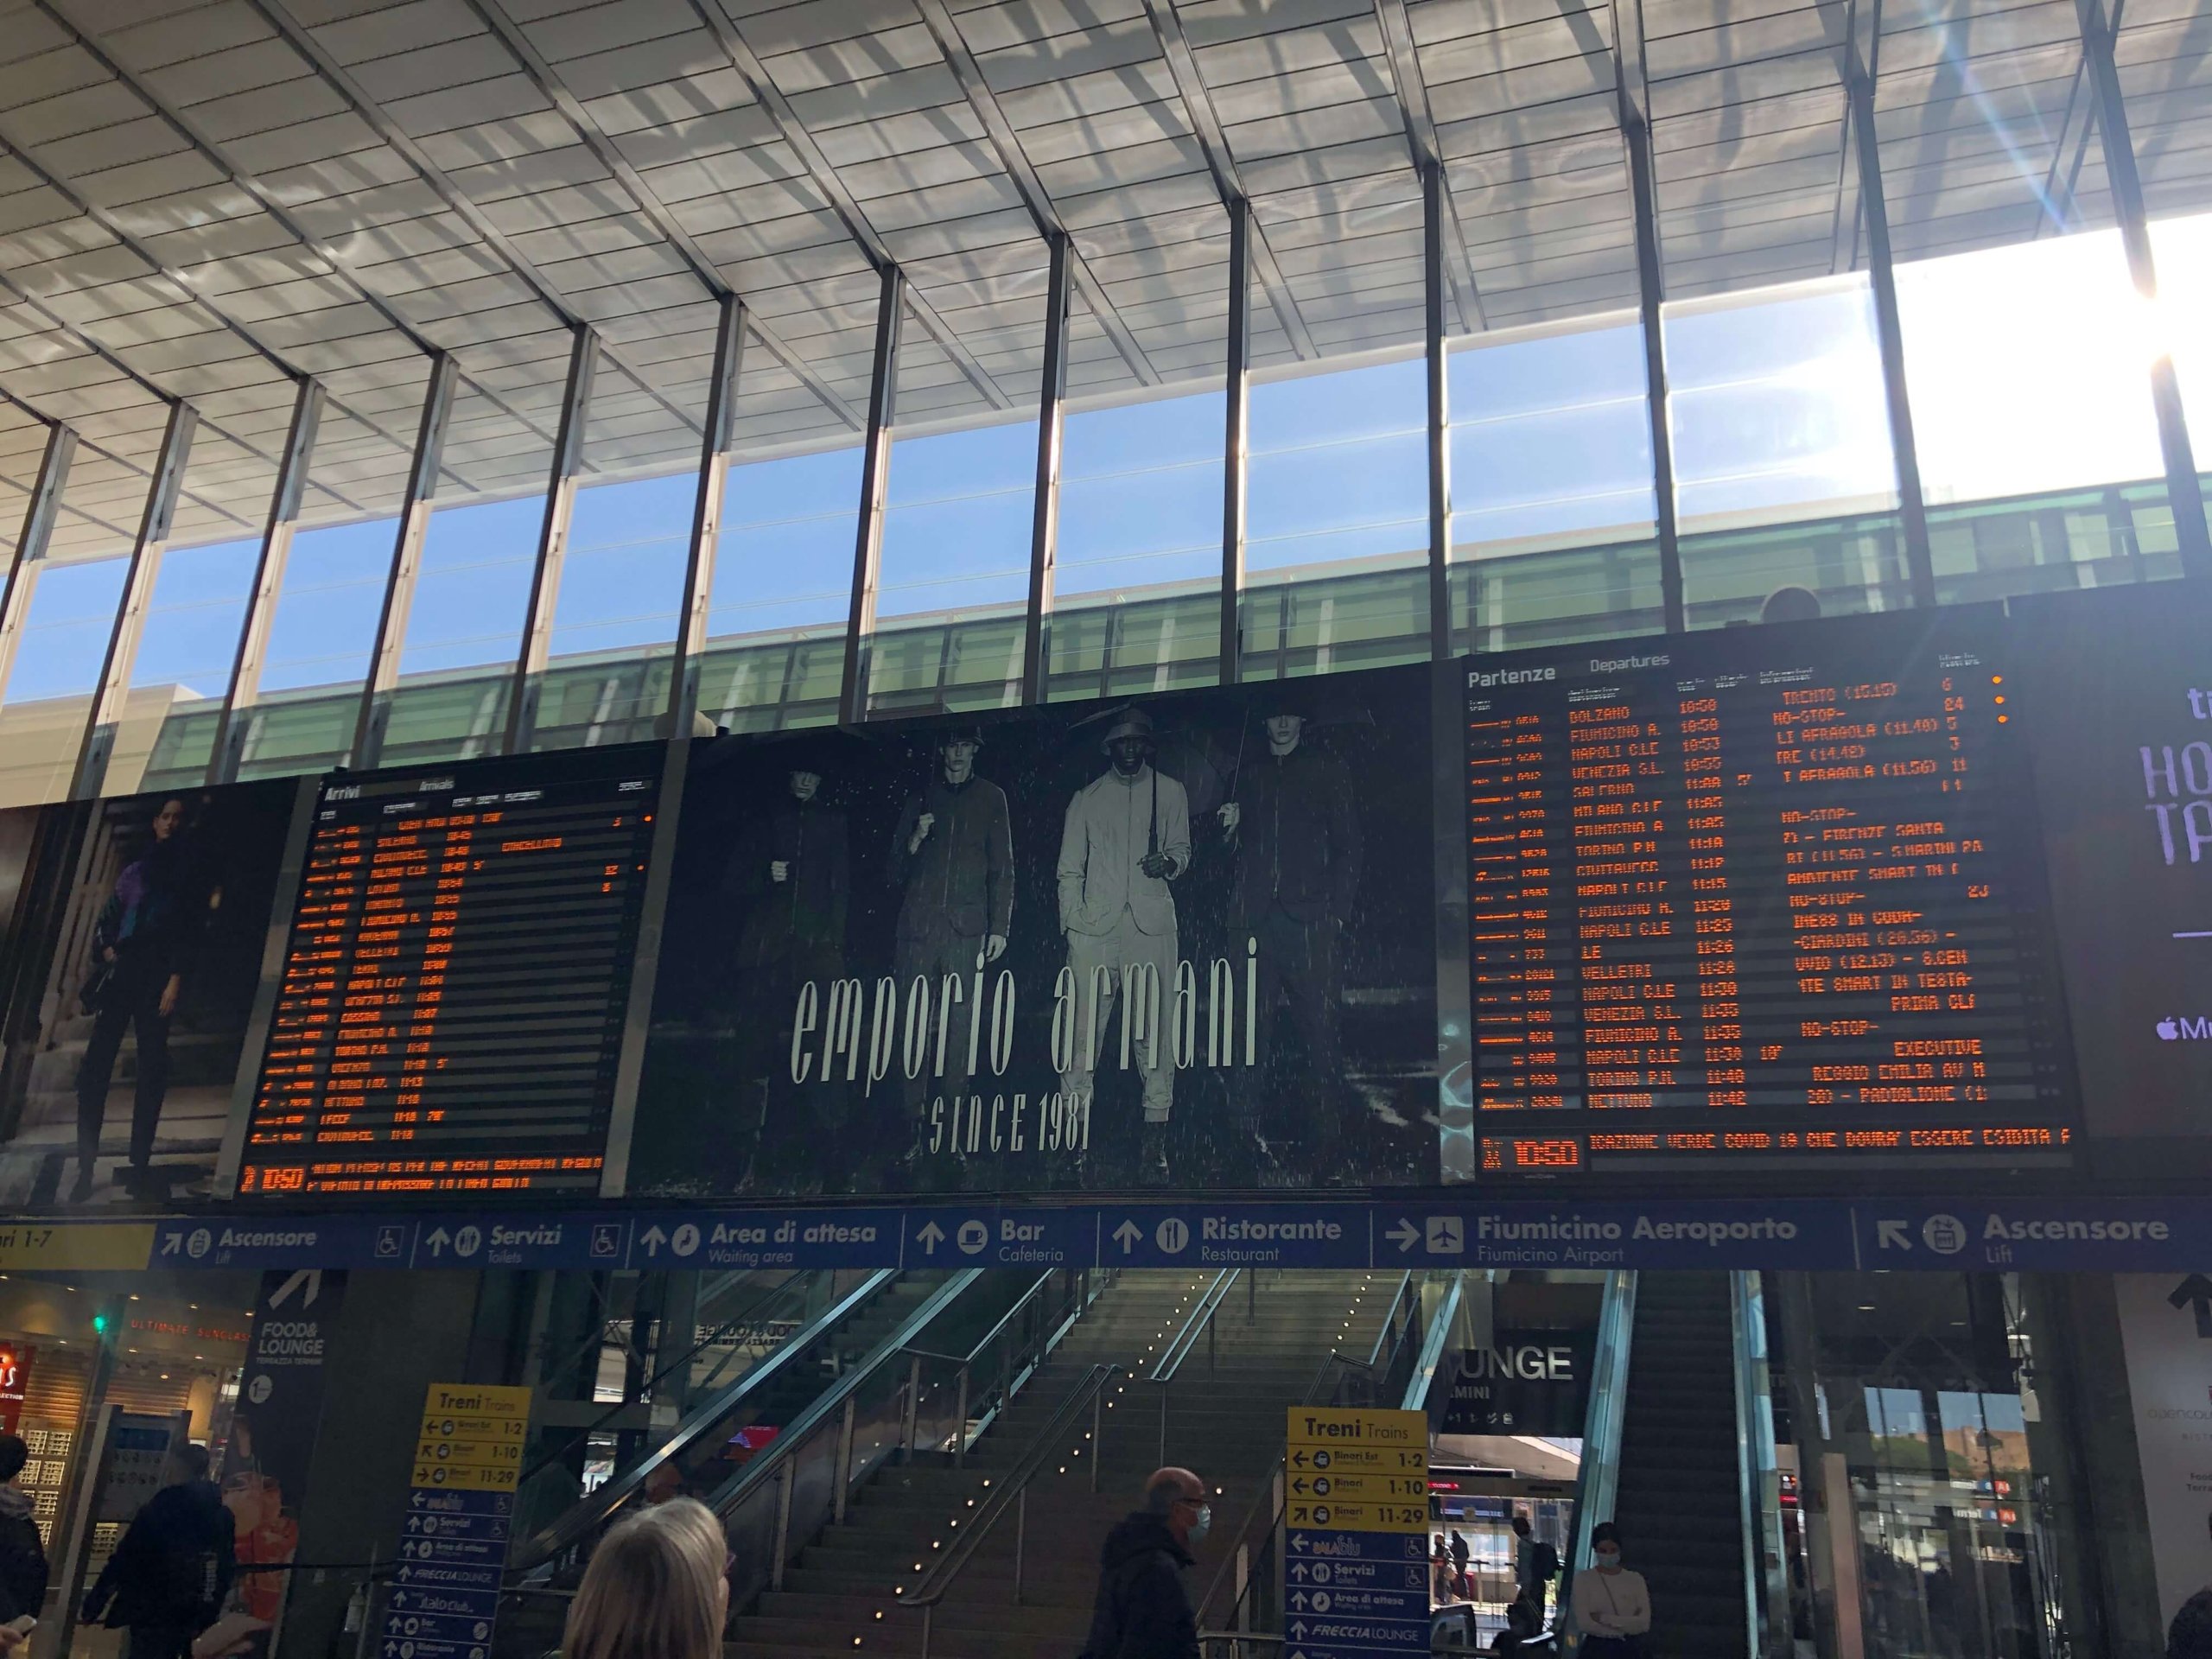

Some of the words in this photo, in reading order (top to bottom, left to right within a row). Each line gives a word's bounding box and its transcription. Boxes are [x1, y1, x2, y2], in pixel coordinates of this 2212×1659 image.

[1590, 655, 1670, 673] Departures
[1469, 667, 1555, 689] Partenze
[1570, 724, 1639, 742] FIUMICINO
[1571, 745, 1621, 760] NAPOLI
[325, 785, 360, 801] Arrivi
[419, 779, 454, 791] Arrivals
[791, 951, 1016, 1098] emporio
[1050, 936, 1258, 1075] armani
[929, 1093, 1027, 1154] SINCE
[1039, 1091, 1091, 1151] 1981
[490, 1224, 563, 1246] Servizi
[710, 1224, 766, 1243] Area
[773, 1221, 797, 1243] di
[804, 1223, 876, 1243] attesa
[1001, 1219, 1045, 1241] Bar
[1202, 1217, 1342, 1240] Ristorante
[1478, 1215, 1622, 1241] Fiumicino
[1632, 1215, 1798, 1247] Aeroporto
[1982, 1214, 2170, 1240] Ascensore
[25, 1230, 53, 1248] 1-7
[219, 1228, 316, 1247] Ascensore
[215, 1251, 231, 1264] Lift
[487, 1249, 523, 1264] Toilets
[709, 1249, 758, 1267] Waiting
[763, 1251, 793, 1263] area
[999, 1245, 1065, 1262] Cafeteria
[1201, 1246, 1280, 1261] Restaurant
[1478, 1246, 1558, 1262] Fiumicino
[1562, 1246, 1624, 1267] Airport
[1986, 1245, 2013, 1264] Lift
[259, 1338, 324, 1355] LOUNGE
[440, 1393, 482, 1410] Treni
[485, 1398, 515, 1411] Trains
[1450, 1386, 1490, 1400] MINI
[1305, 1418, 1361, 1437] Treni
[1366, 1423, 1408, 1440] Trains
[1334, 1451, 1363, 1460] Binari
[1366, 1452, 1378, 1460] Est
[1334, 1478, 1363, 1487] Binari
[1334, 1506, 1363, 1516] Binari
[1334, 1564, 1375, 1576] Servizi
[1334, 1591, 1359, 1603] Area
[1363, 1593, 1372, 1603] di
